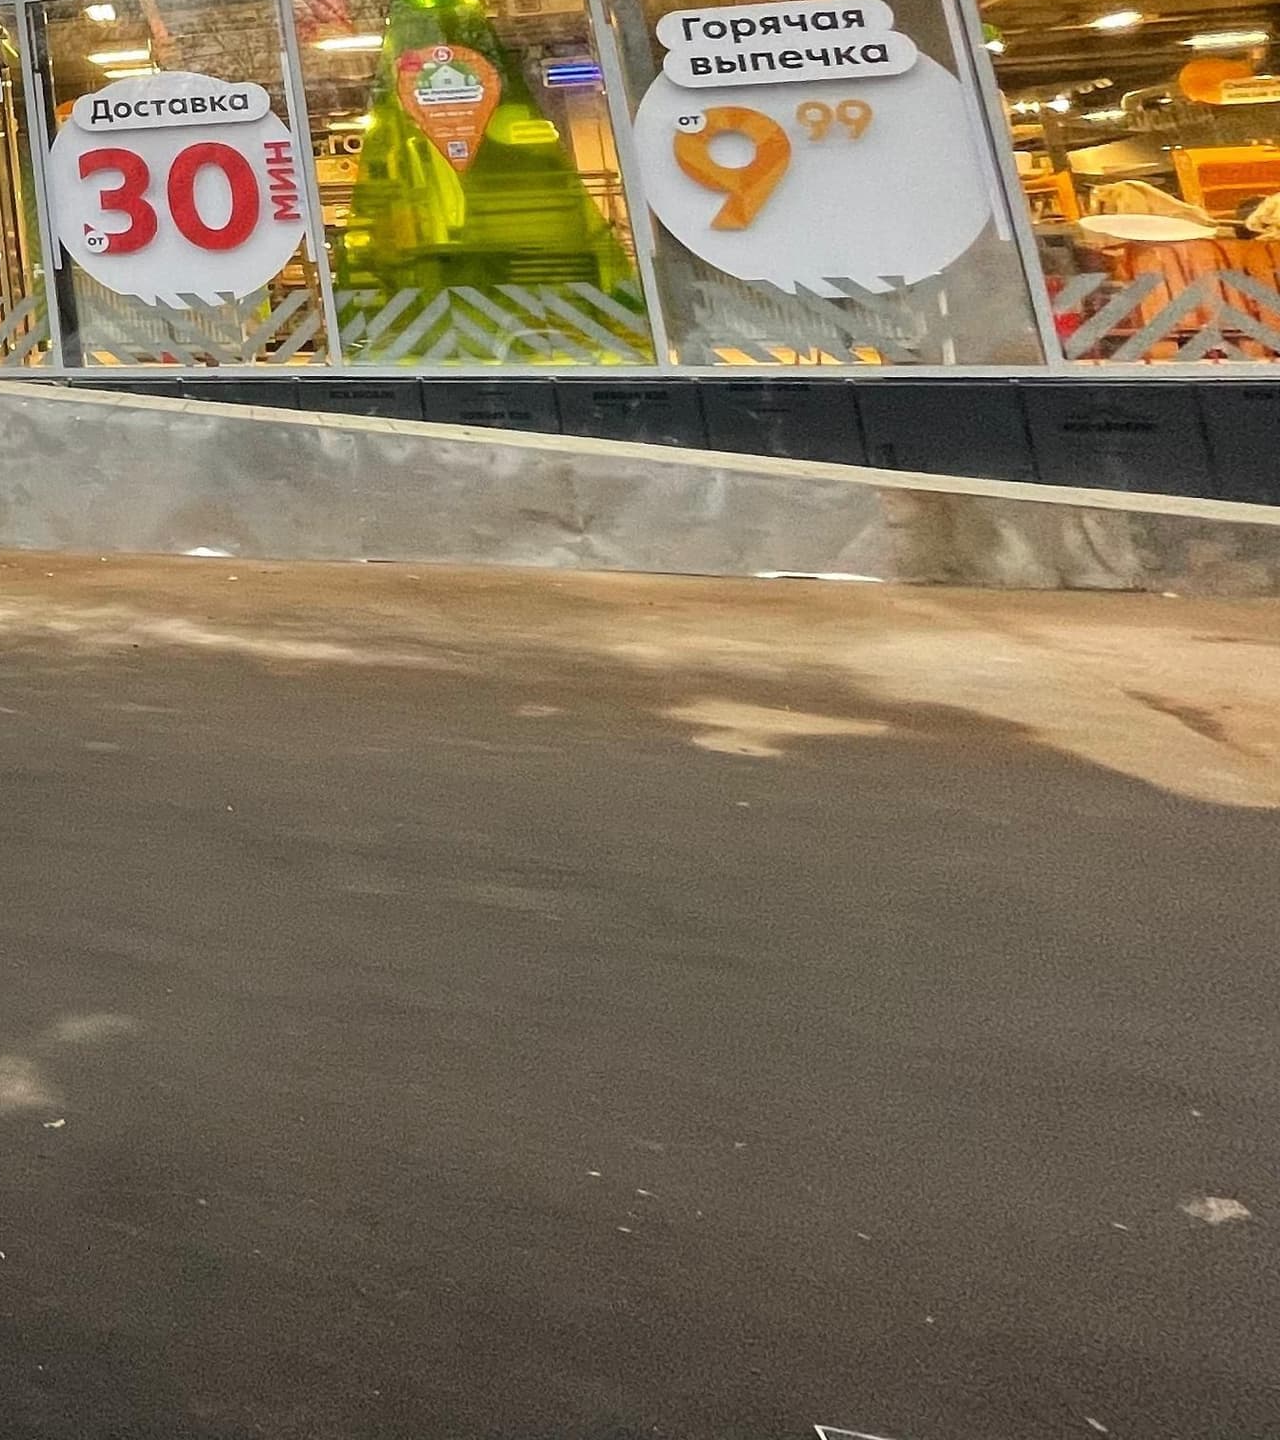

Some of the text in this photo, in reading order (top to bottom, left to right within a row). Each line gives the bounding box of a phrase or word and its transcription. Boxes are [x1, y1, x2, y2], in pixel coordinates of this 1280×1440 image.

[681, 9, 866, 44] Горячая
[690, 43, 890, 76] выпечка
[90, 93, 249, 125] Доставка
[78, 141, 261, 256] 30
[87, 236, 105, 247] от
